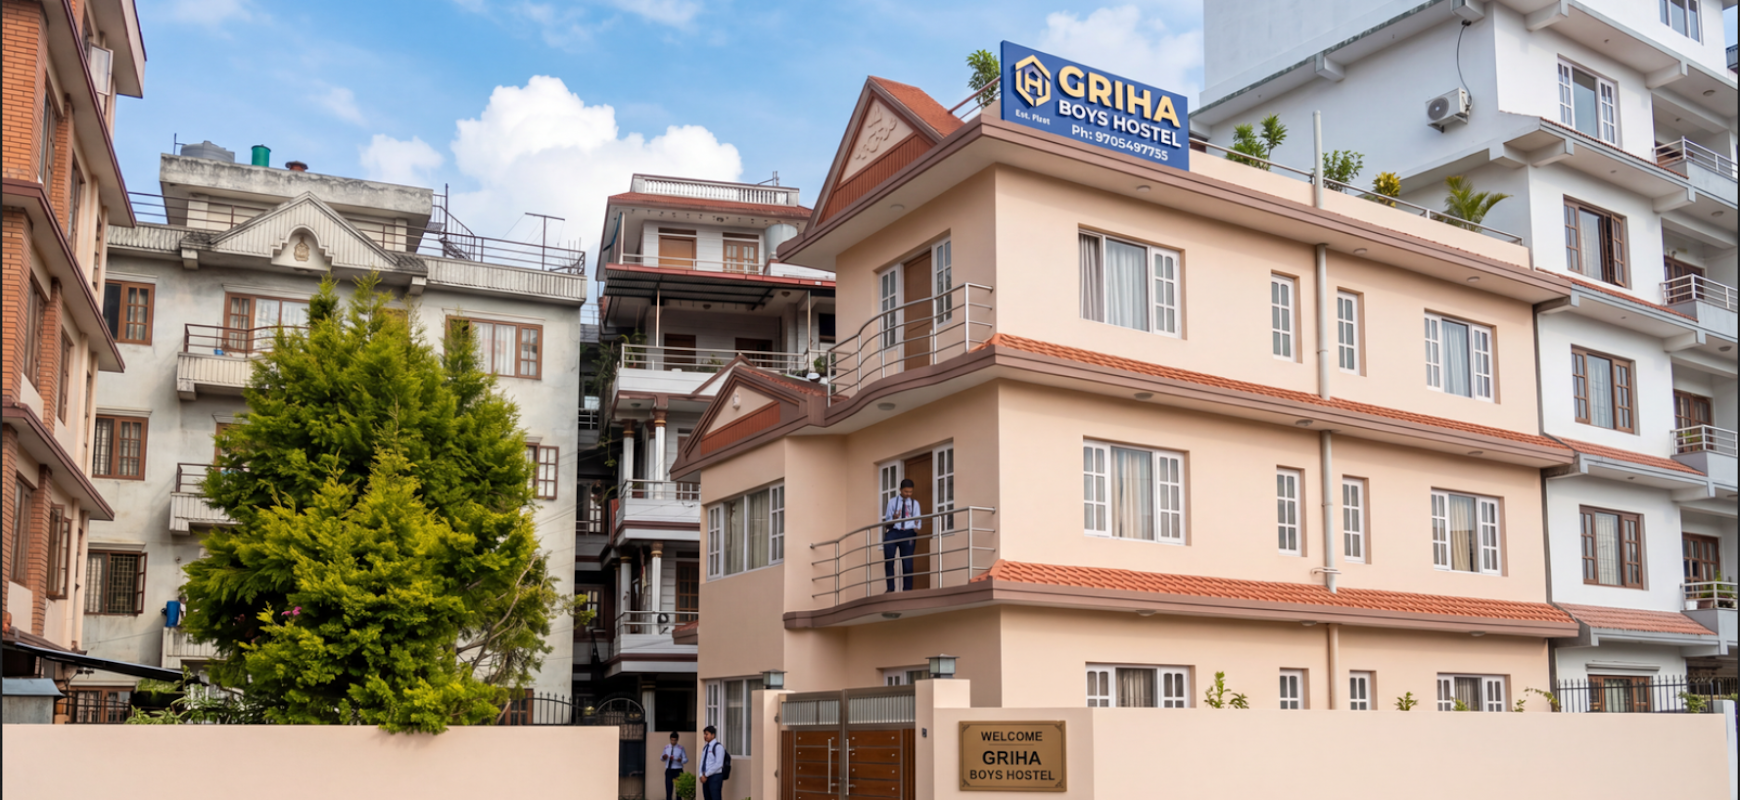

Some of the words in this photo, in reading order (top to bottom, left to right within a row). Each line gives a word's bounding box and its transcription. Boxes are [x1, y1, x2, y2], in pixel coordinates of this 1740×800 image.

[1058, 65, 1181, 129] GRIHA
[1015, 109, 1031, 120] Est.
[1059, 99, 1108, 126] BOYS
[1113, 115, 1182, 148] HOSTEL
[1071, 124, 1093, 140] Ph:
[1095, 131, 1169, 161] 9705497755
[981, 731, 1043, 741] WELCOME
[982, 750, 1042, 765] GRIHA
[970, 769, 1003, 780] BOYS
[1006, 770, 1055, 780] HOSTEL
